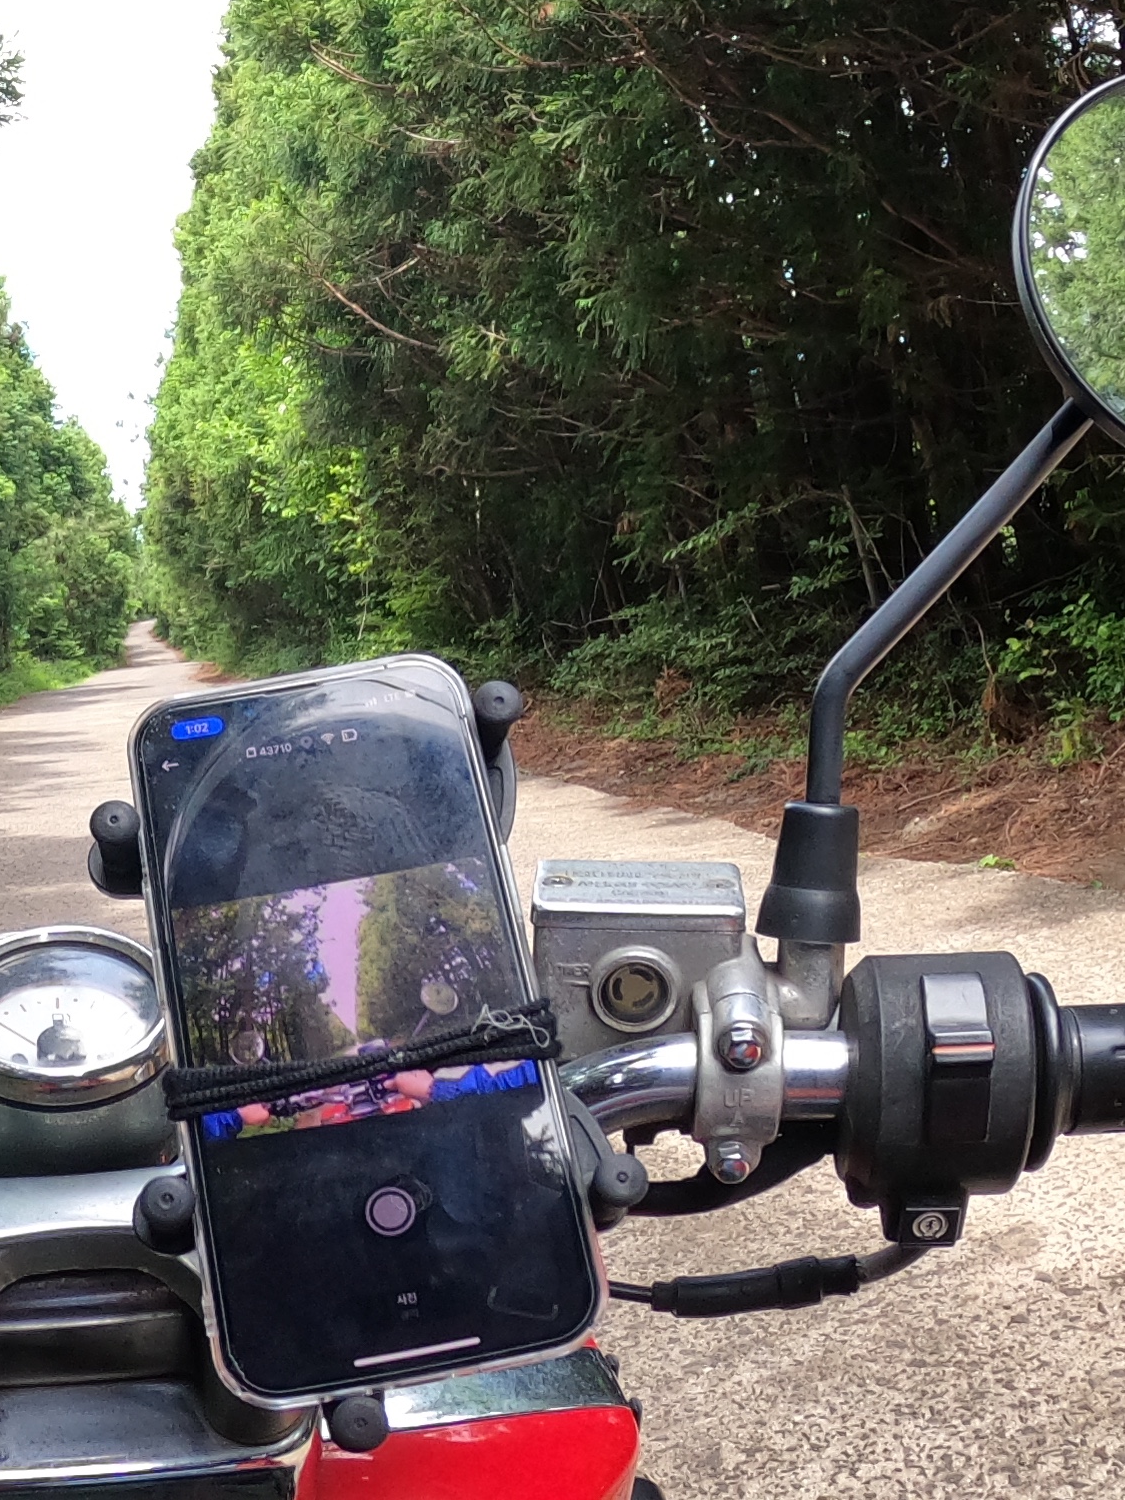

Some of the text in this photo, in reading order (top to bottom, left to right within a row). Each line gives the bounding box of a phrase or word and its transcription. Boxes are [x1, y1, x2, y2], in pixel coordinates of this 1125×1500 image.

[185, 723, 209, 735] 1:02
[259, 742, 292, 756] 43710
[723, 1088, 755, 1109] UP
